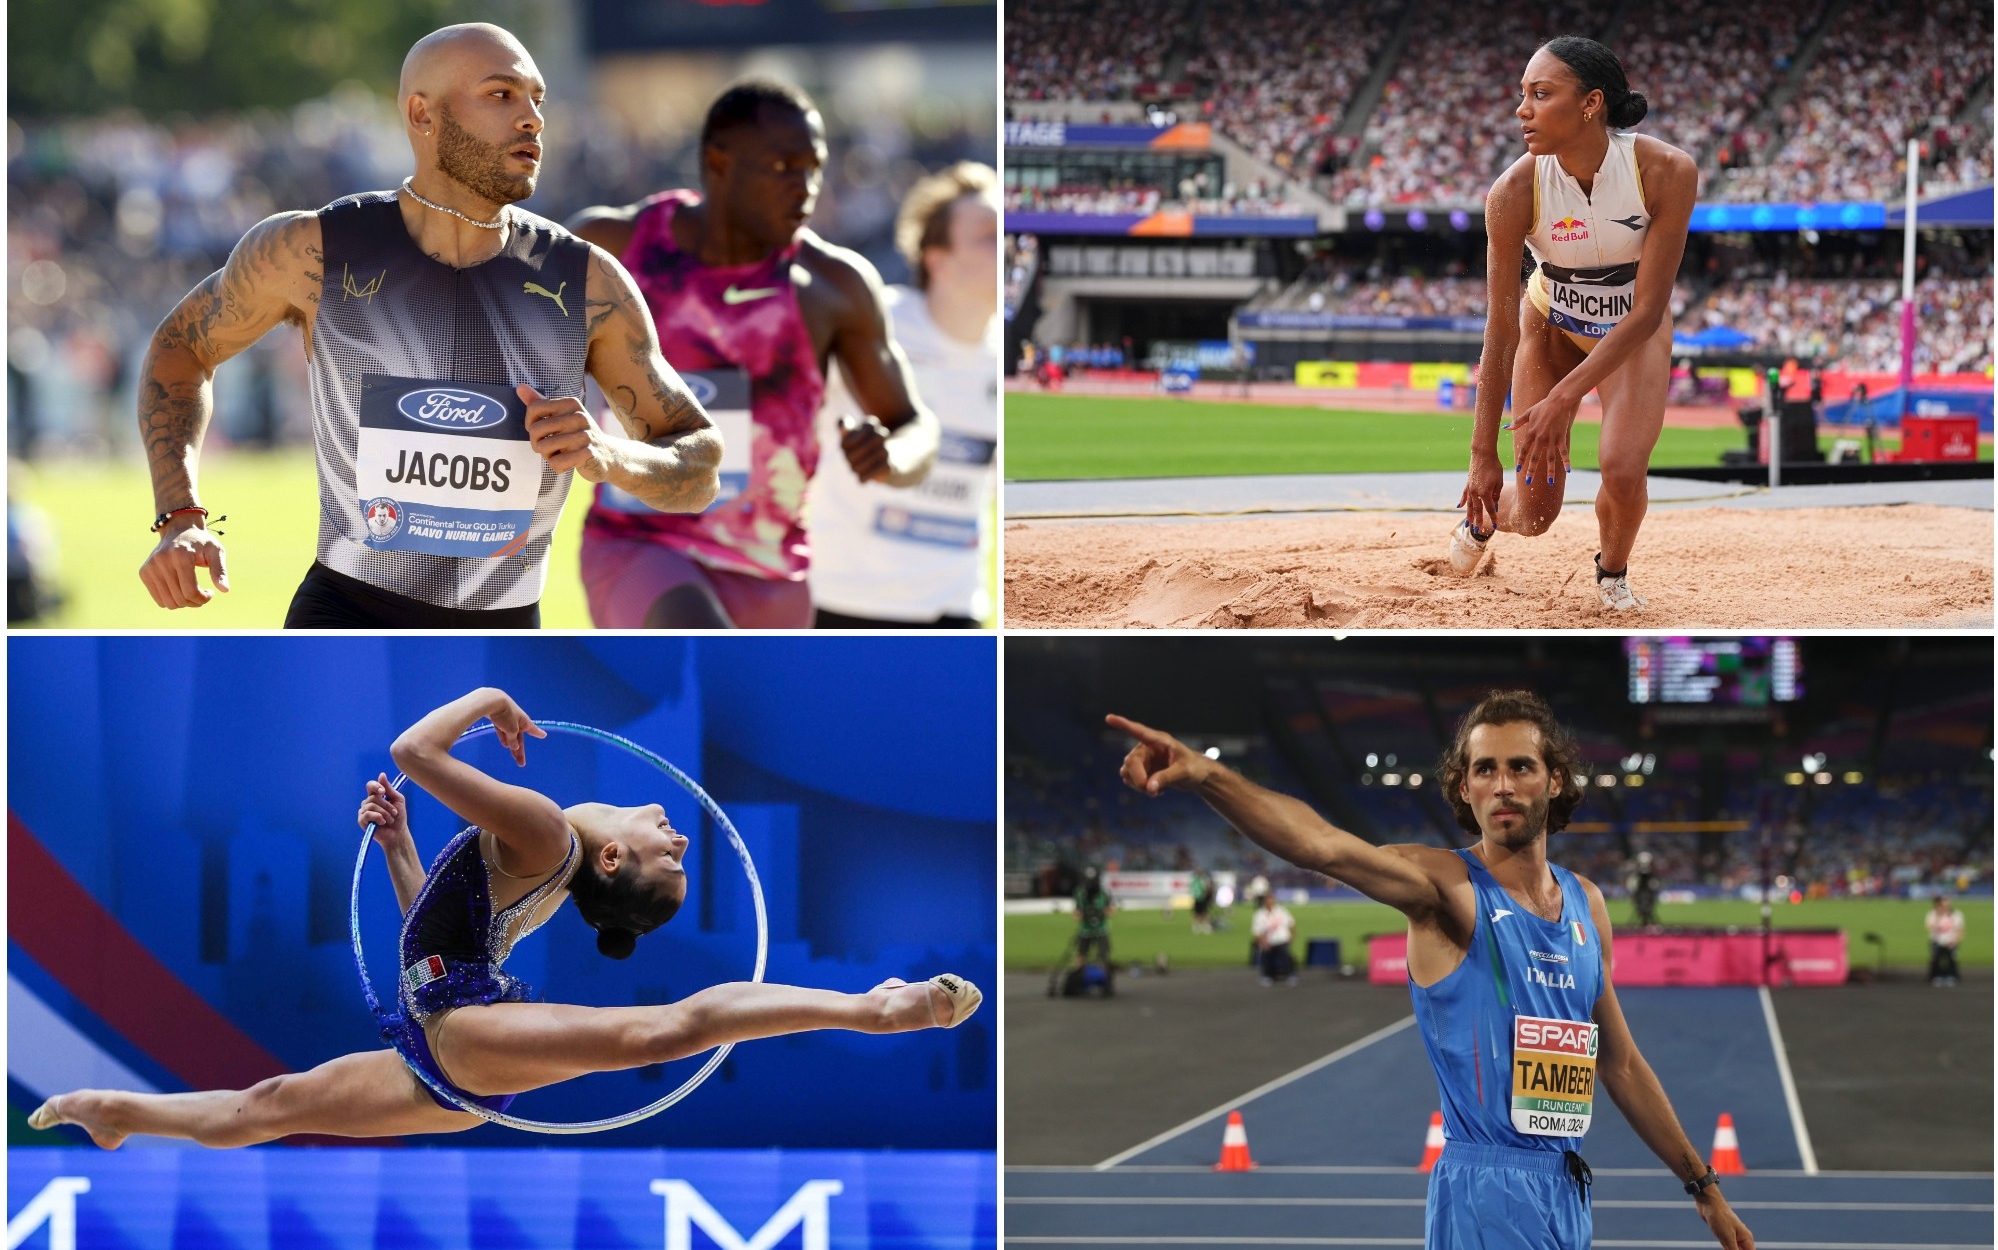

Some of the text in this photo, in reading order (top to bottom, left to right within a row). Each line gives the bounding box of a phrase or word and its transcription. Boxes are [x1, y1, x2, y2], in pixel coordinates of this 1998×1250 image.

[1004, 121, 1066, 145] TAGE
[1551, 231, 1589, 242] Red Bull
[1553, 282, 1635, 317] IAPICHIN
[1584, 324, 1615, 335] LON
[418, 393, 487, 424] Ford
[385, 449, 512, 493] JACOBS
[408, 515, 455, 529] Continental
[455, 521, 472, 530] Tour
[473, 522, 497, 531] GOLD
[498, 522, 516, 530] Turku
[408, 525, 515, 542] PAAVO NURMI GAMES
[1527, 966, 1576, 990] ITALIA
[1519, 1023, 1589, 1050] SPAR
[1517, 1060, 1594, 1096] TAMBERI
[1537, 1100, 1541, 1109] I
[1542, 1100, 1564, 1111] RUN
[1529, 1115, 1584, 1132] ROMA 2024
